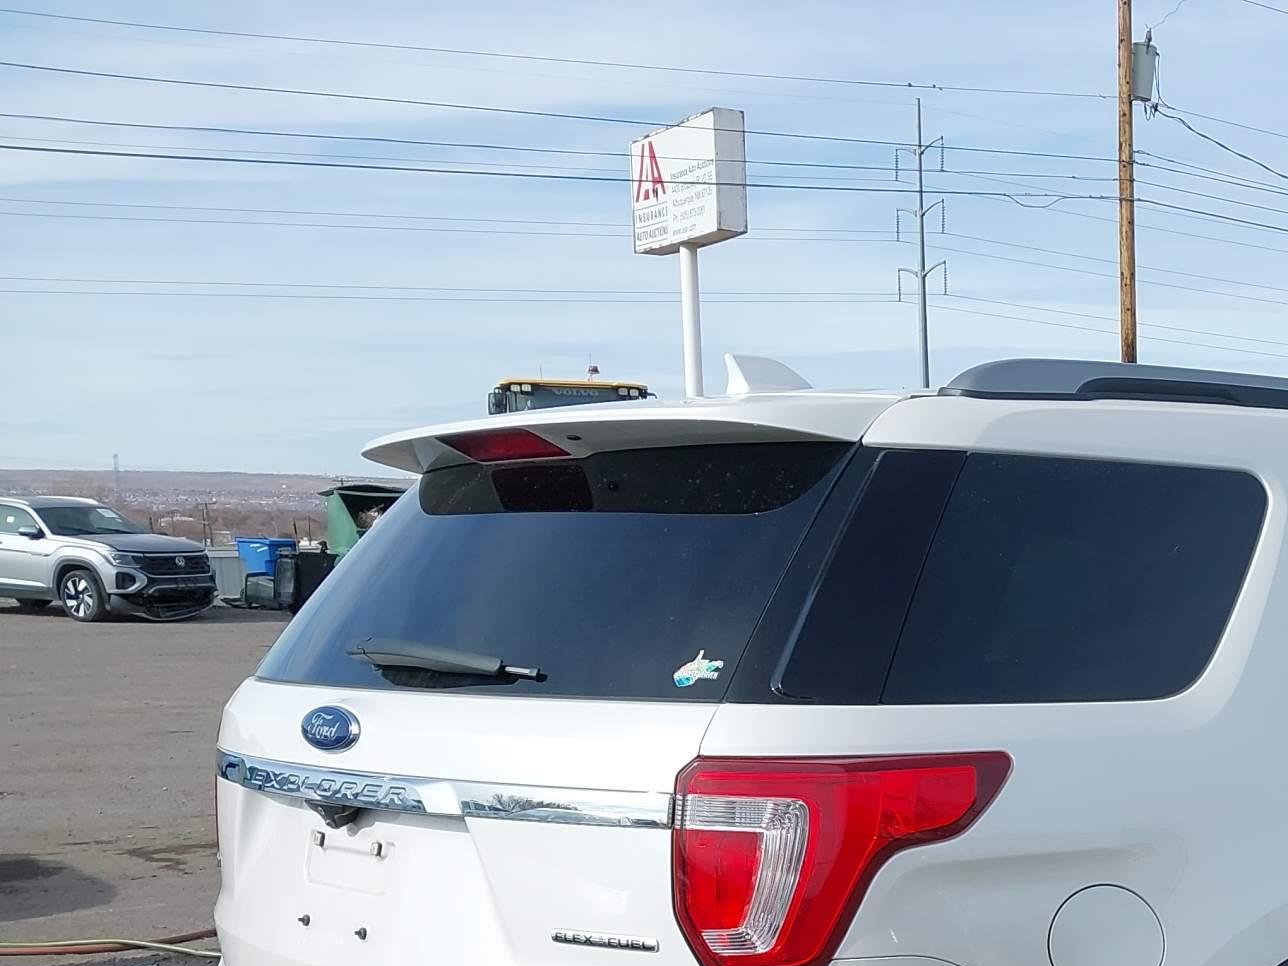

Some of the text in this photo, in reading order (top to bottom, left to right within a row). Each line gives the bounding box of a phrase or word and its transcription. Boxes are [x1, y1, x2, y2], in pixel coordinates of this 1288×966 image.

[635, 206, 668, 224] INSURANCE
[306, 711, 340, 741] Ford
[251, 769, 407, 804] EXPLORER
[554, 931, 656, 951] FLEX FUEL
